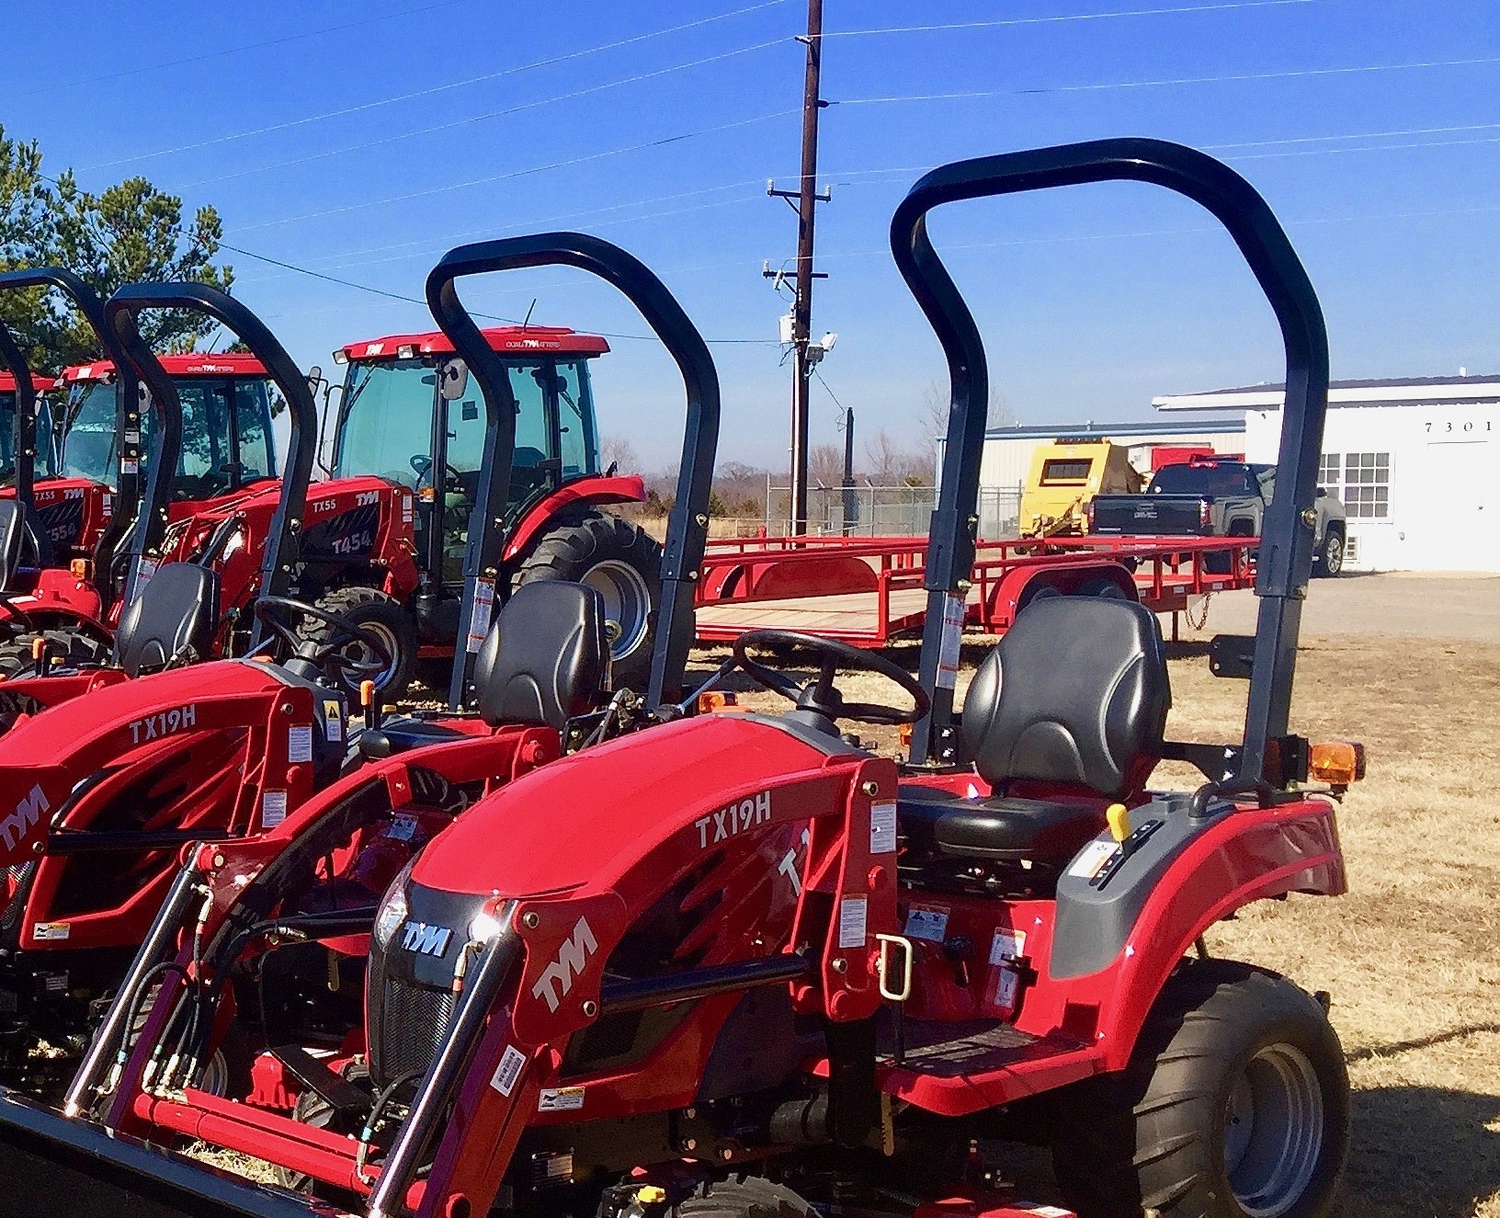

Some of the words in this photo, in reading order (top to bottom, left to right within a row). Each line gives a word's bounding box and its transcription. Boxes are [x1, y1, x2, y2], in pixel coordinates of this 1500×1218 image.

[1425, 421, 1491, 432] 7301
[63, 488, 84, 500] TYM
[313, 499, 336, 513] TX55
[356, 490, 379, 506] TYM
[129, 704, 196, 744] TX19H
[695, 790, 771, 849] TX19H
[403, 921, 452, 958] TYM
[532, 915, 598, 1014] TYM
